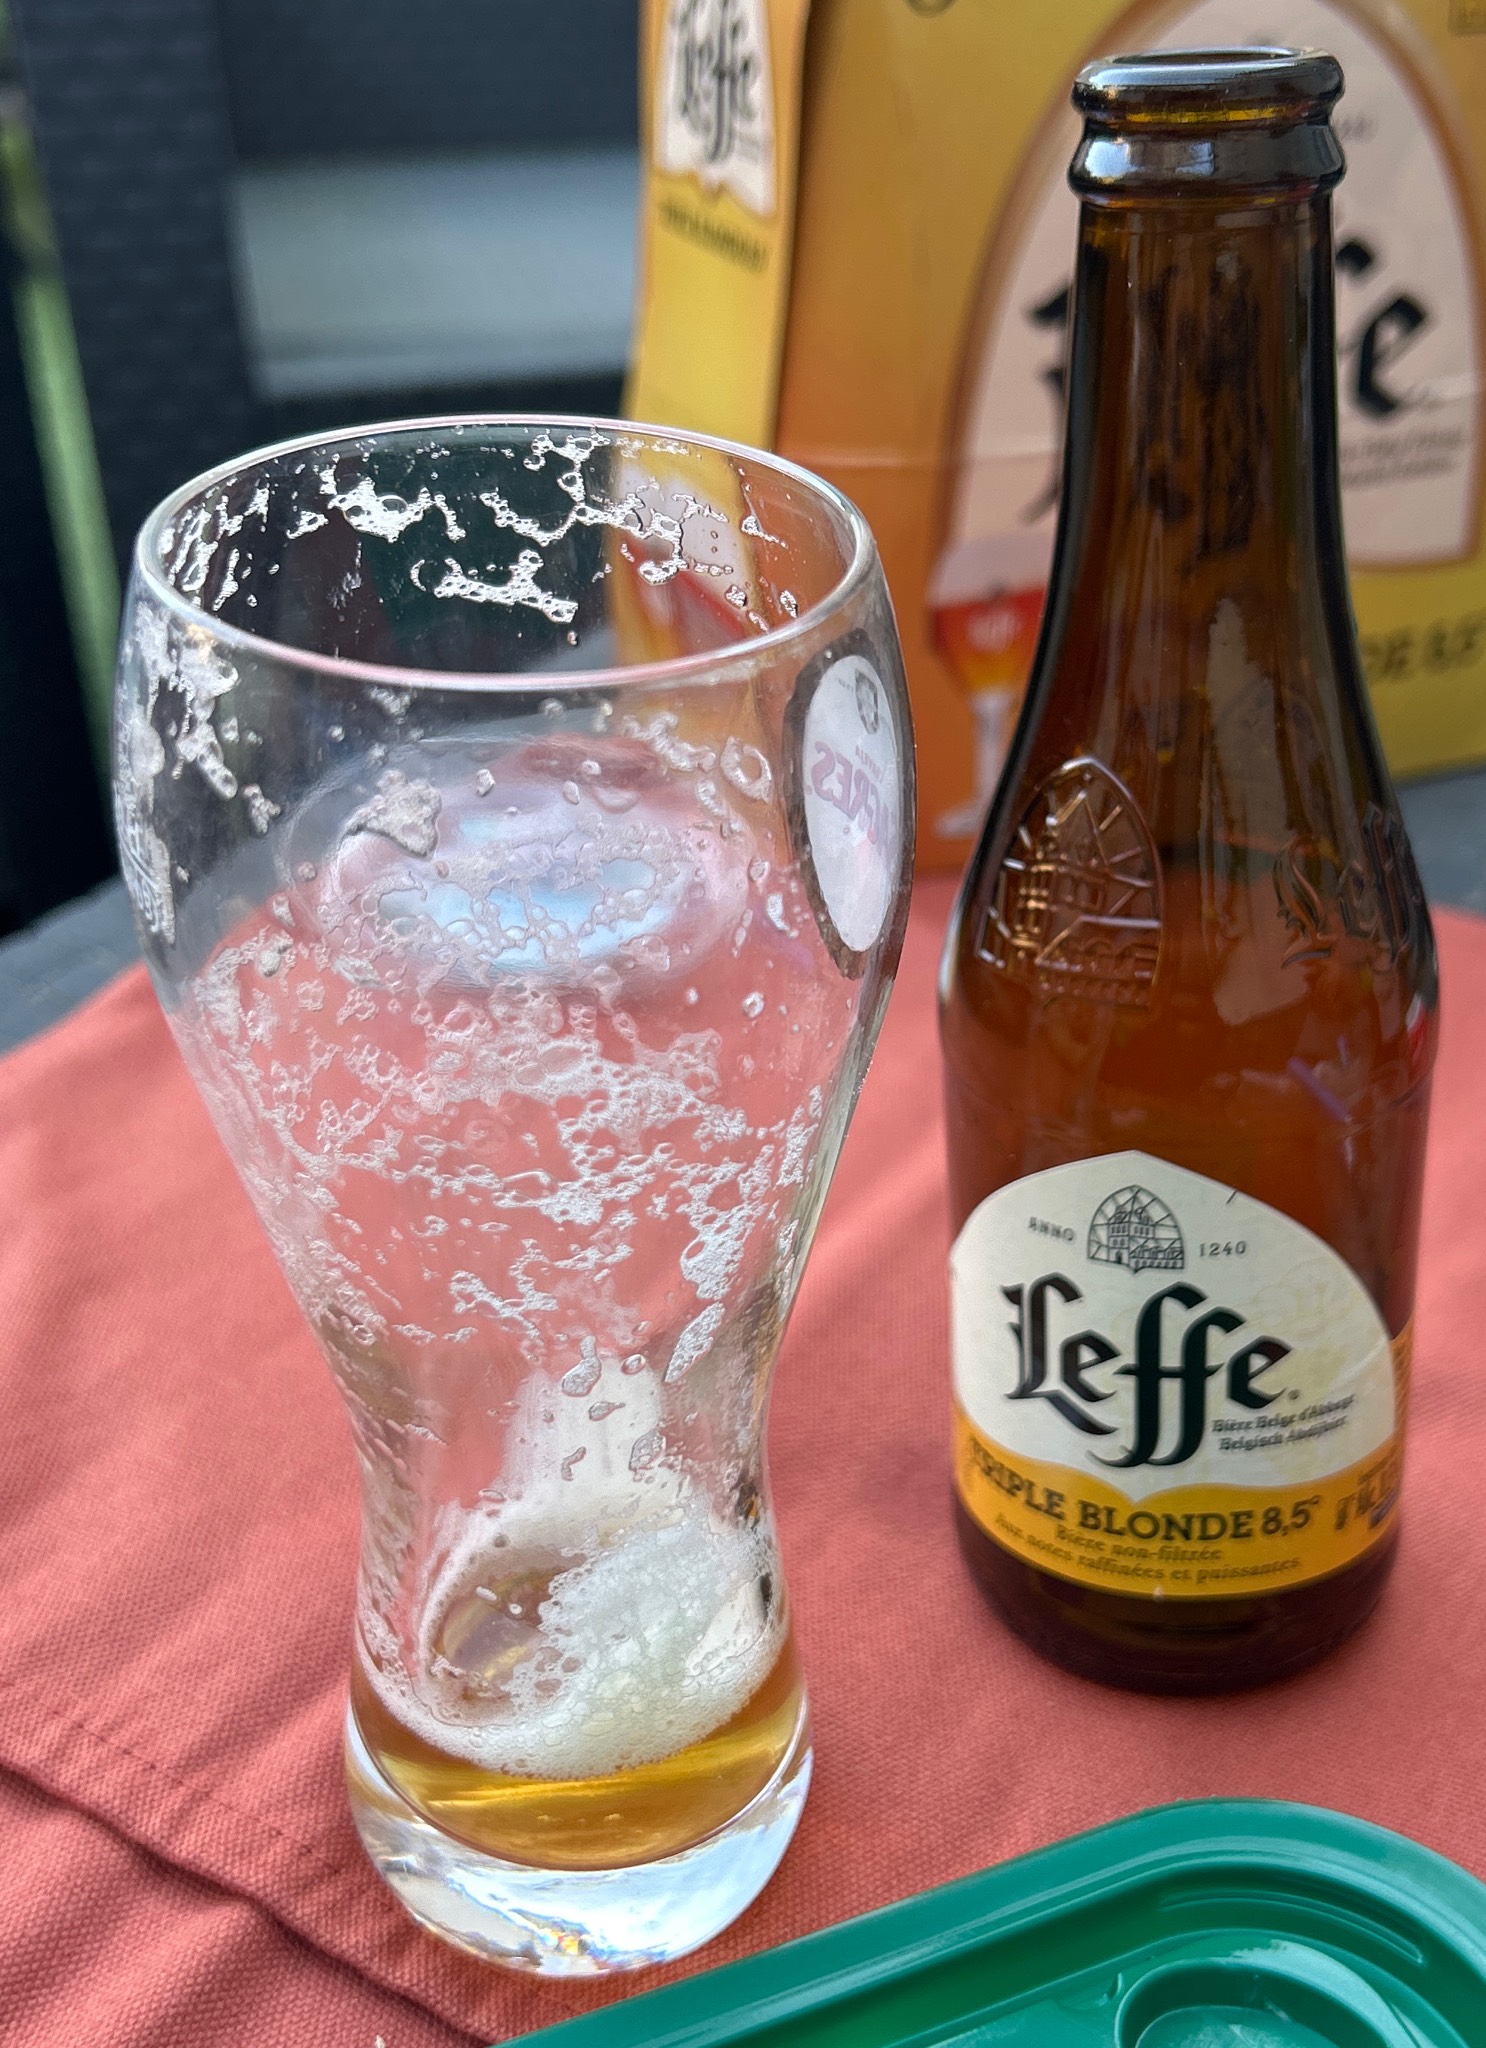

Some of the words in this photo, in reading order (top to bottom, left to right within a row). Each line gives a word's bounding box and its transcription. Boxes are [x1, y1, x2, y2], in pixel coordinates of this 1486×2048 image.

[1028, 1216, 1075, 1242] ANNO
[1200, 1240, 1248, 1258] 1240
[1001, 1271, 1294, 1468] Leffe
[1212, 1418, 1253, 1433] Bière
[971, 1437, 1066, 1521] TRIPLE
[1078, 1498, 1255, 1542] BLONDE
